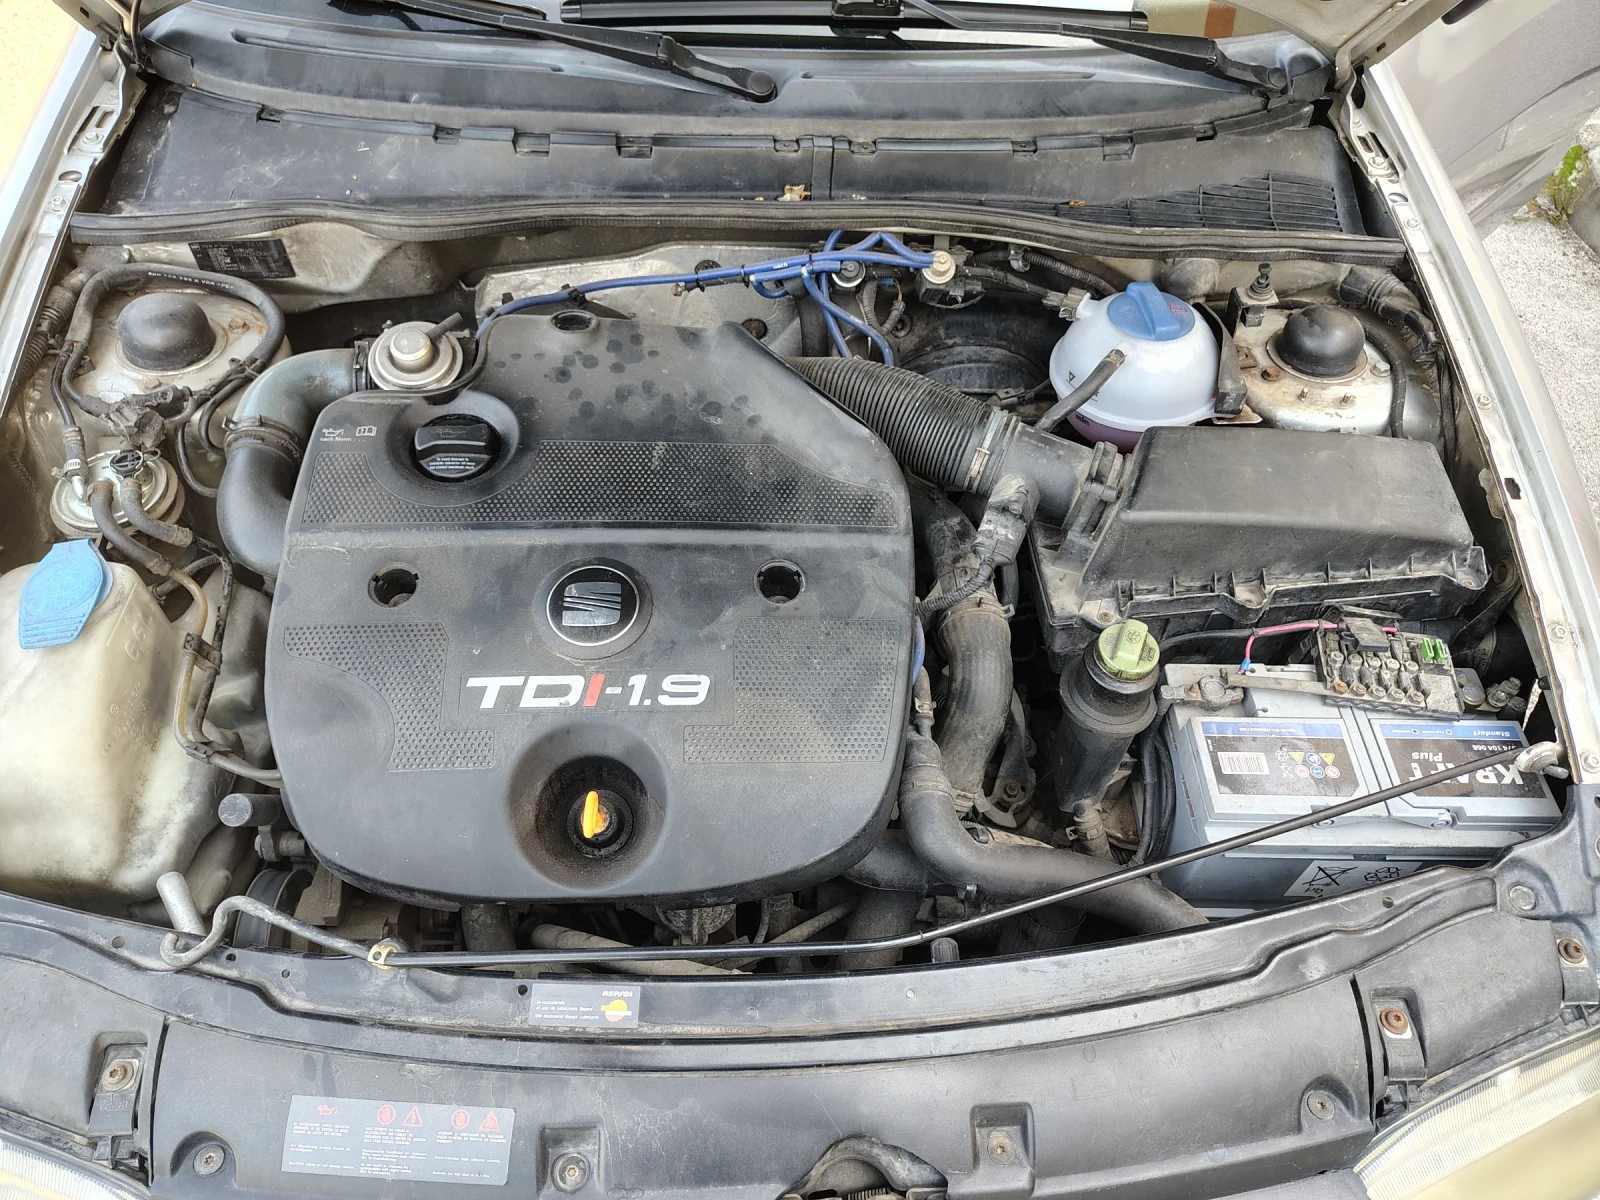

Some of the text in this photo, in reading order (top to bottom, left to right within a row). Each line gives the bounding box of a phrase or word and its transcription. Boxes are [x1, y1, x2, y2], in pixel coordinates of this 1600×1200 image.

[1075, 412, 1090, 426] min
[1411, 752, 1443, 761] Plus
[602, 990, 634, 998] REPSOL
